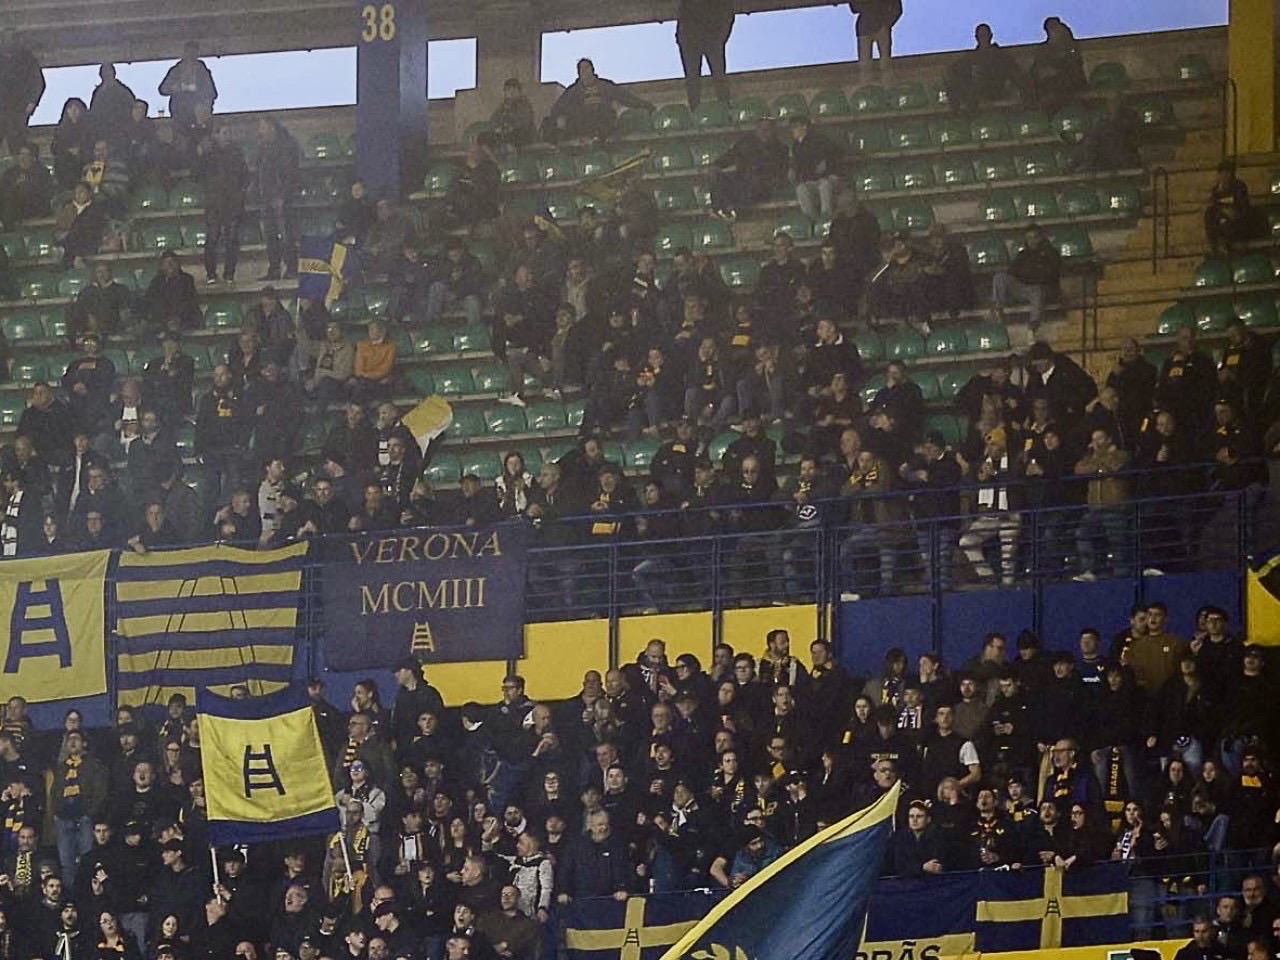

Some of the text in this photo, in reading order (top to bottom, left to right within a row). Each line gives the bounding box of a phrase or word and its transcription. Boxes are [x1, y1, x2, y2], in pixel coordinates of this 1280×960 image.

[361, 5, 396, 42] 38
[351, 532, 502, 565] VERONA
[361, 577, 487, 615] MCMIII
